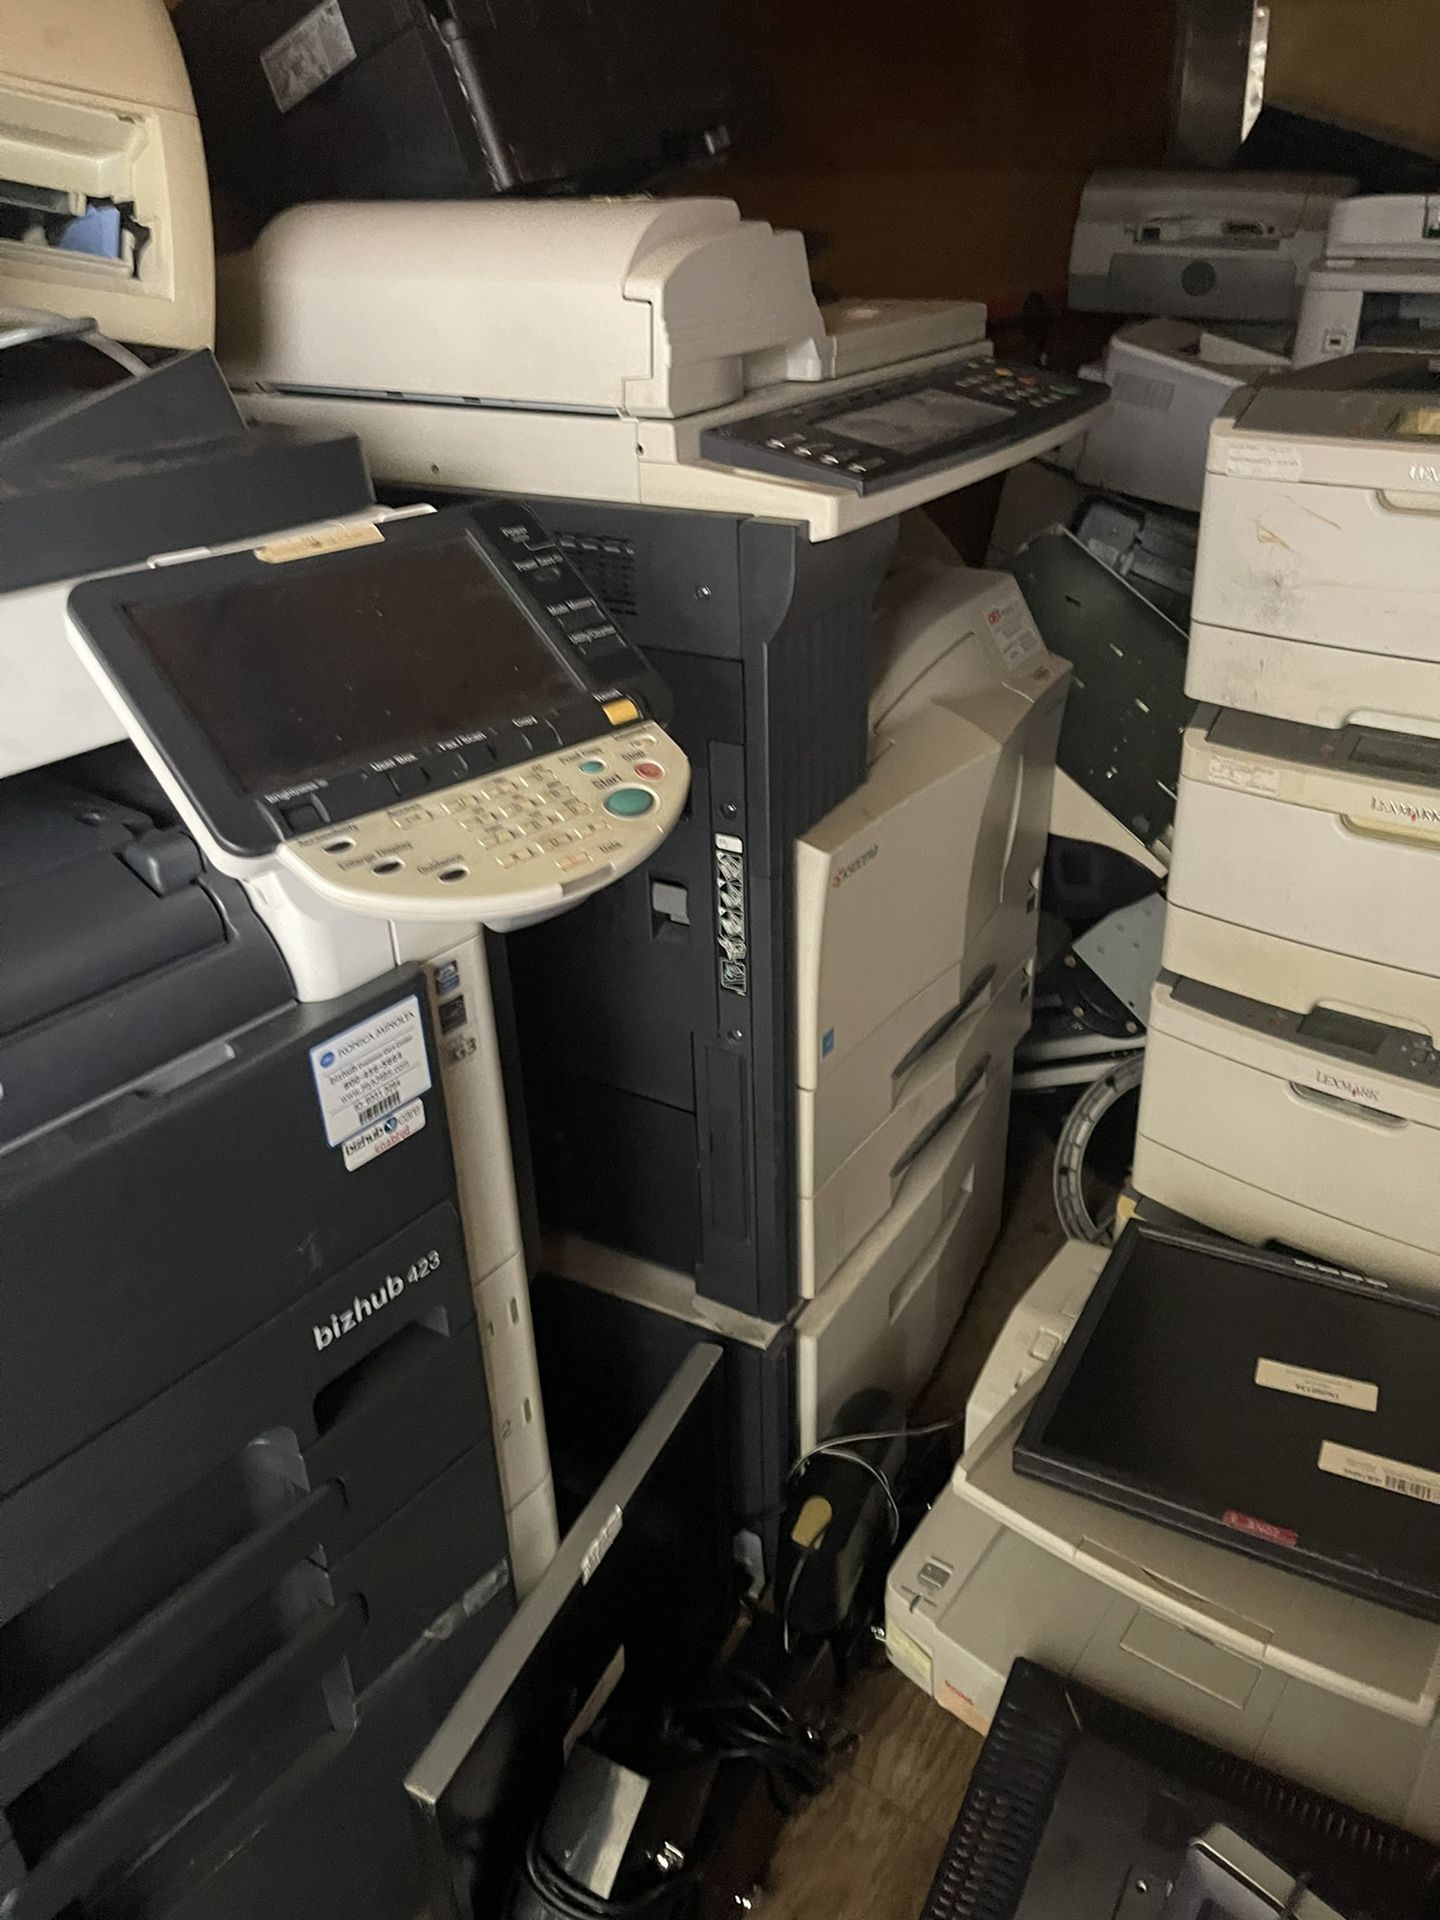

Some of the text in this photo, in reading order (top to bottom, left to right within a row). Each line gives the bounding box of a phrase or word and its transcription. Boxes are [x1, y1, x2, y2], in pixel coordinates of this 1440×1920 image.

[1315, 1068, 1380, 1101] LEXMARK
[312, 1249, 441, 1352] bizhub 423
